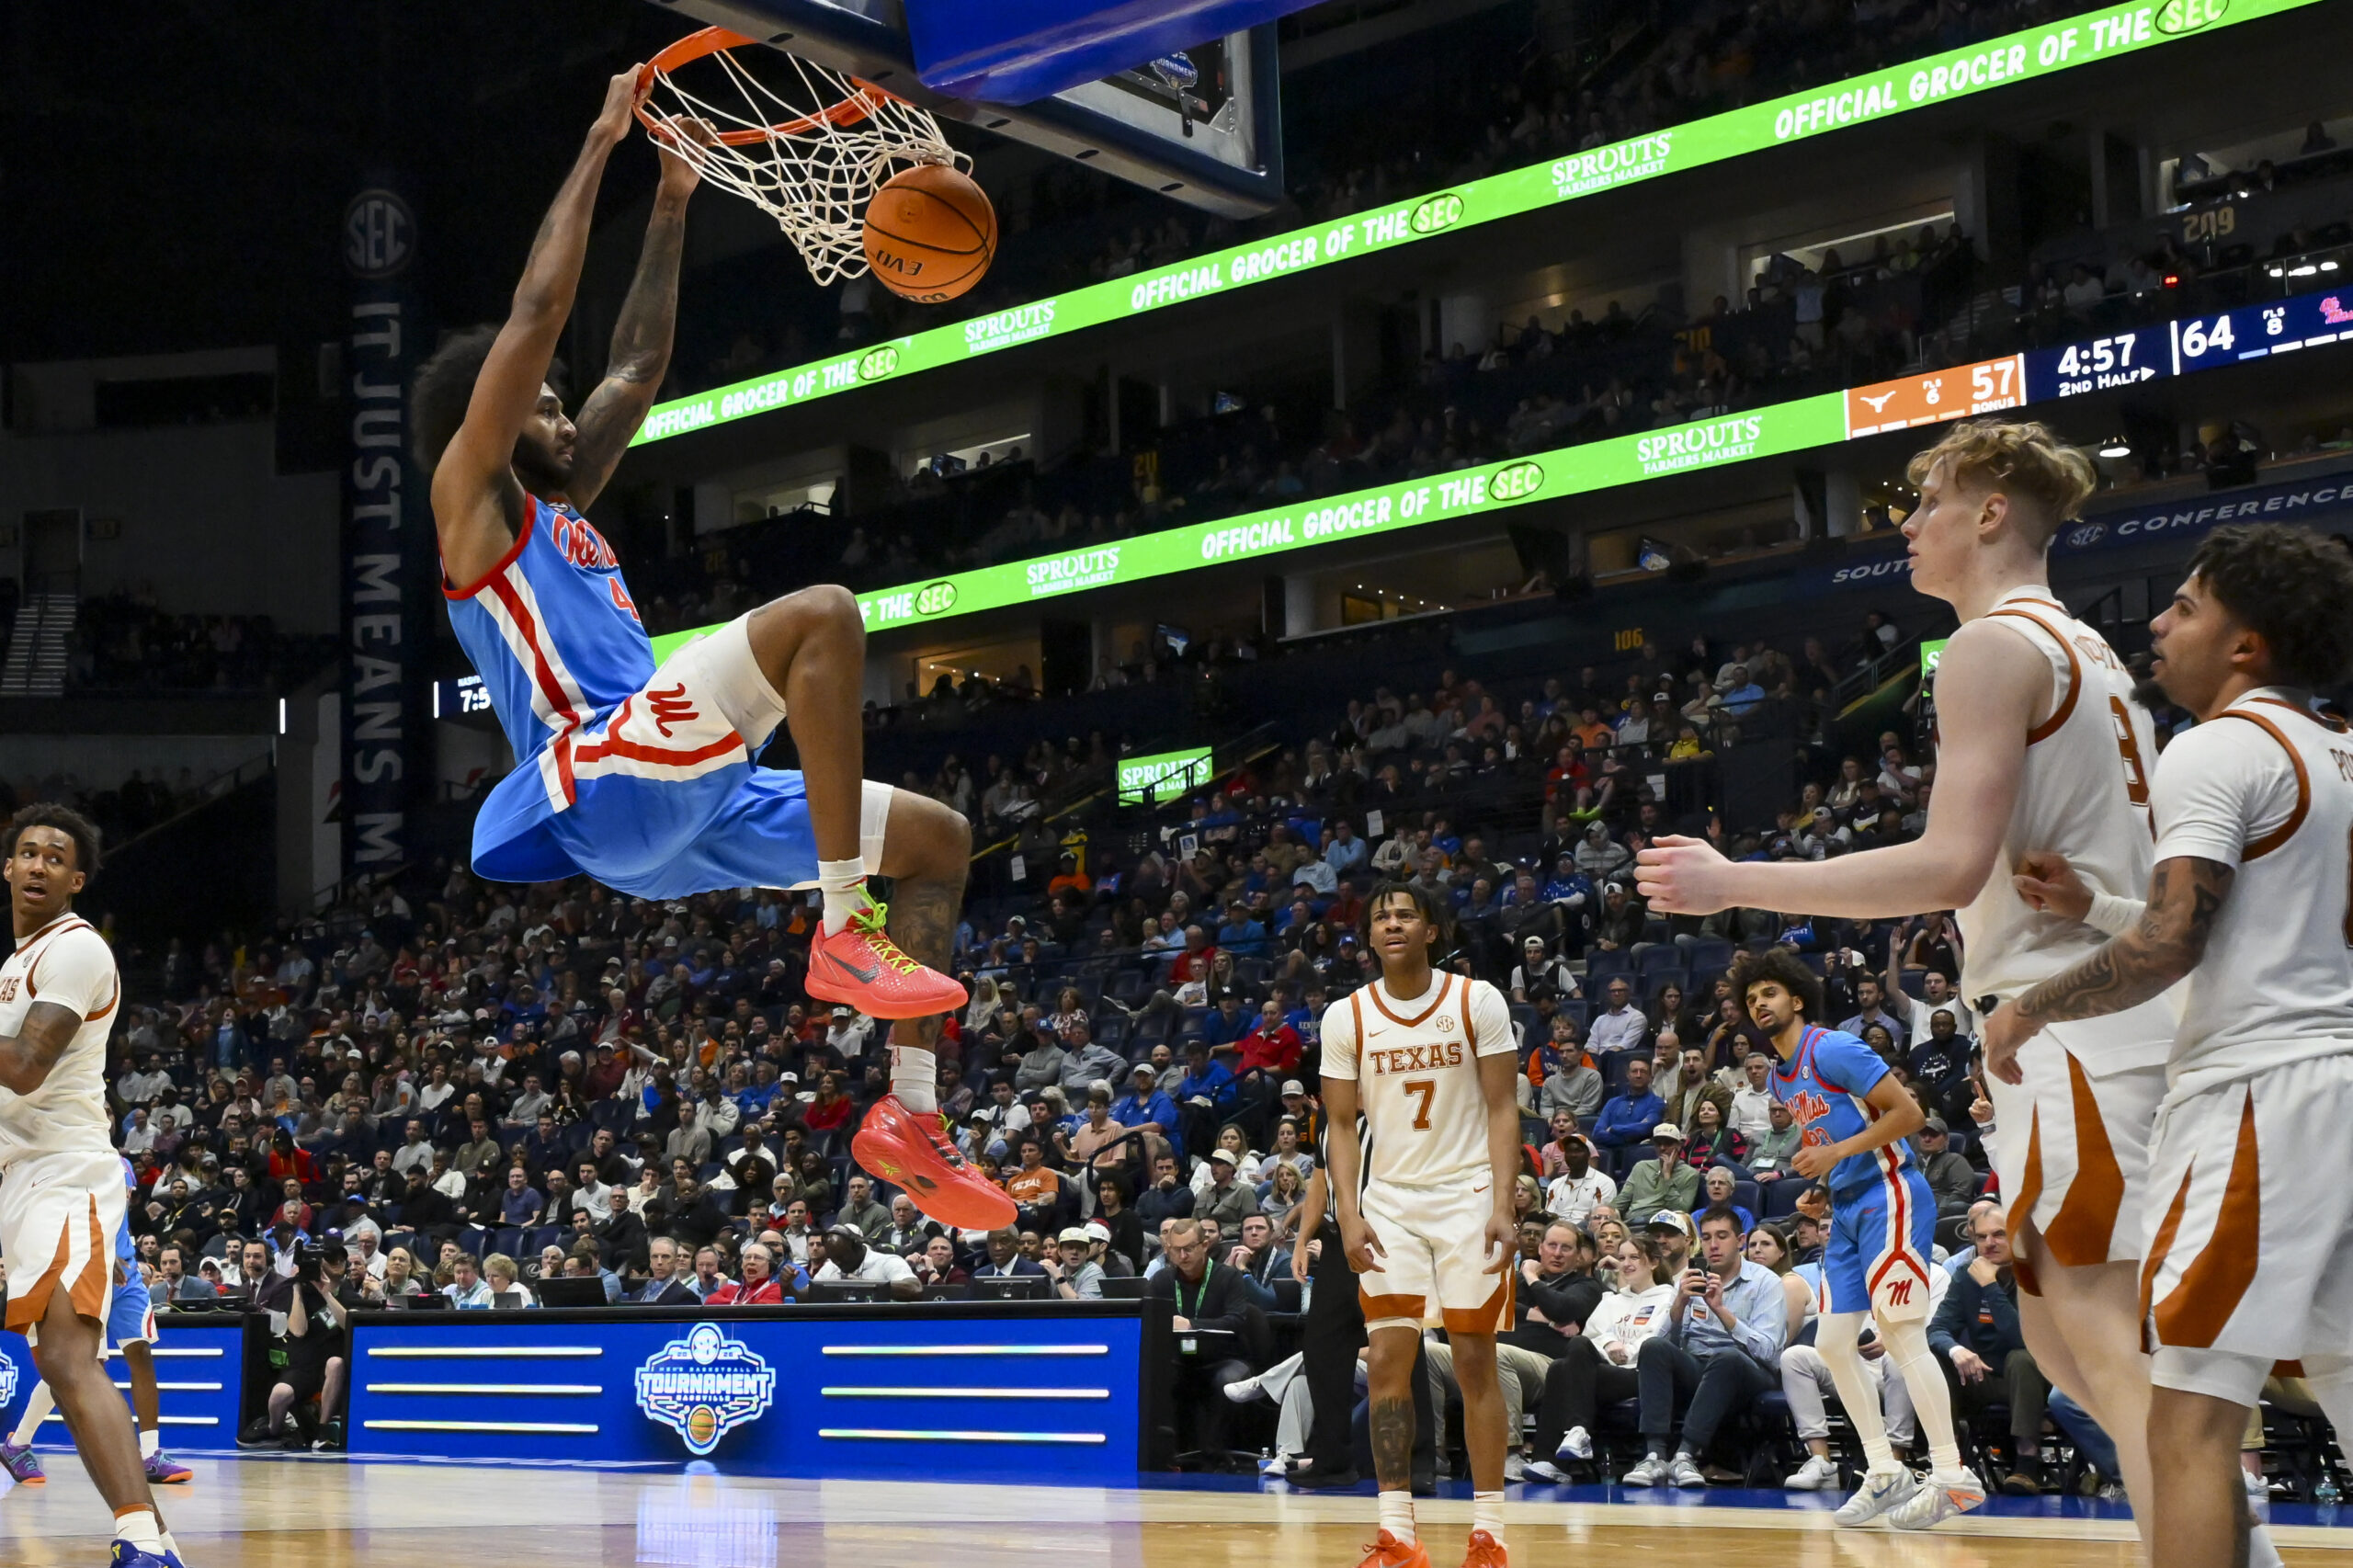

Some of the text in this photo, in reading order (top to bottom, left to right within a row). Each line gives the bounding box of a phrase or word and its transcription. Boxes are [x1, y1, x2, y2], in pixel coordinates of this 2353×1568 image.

[1775, 0, 2222, 139] OFFICIAL GROCER OF THE SEC
[1552, 132, 1672, 186] SPROUTS
[1558, 159, 1665, 198] FARMERS MARKET
[347, 199, 407, 269] SEC
[1131, 196, 1461, 310] OFFICIAL GROCER OF THE SEC
[876, 249, 924, 276] EVO
[353, 302, 402, 358] IT
[965, 300, 1056, 343] SPROUTS
[969, 323, 1051, 354] FARMERS MARKET
[2182, 315, 2234, 358] 64
[2267, 318, 2283, 335] 8
[2058, 334, 2135, 378] 4:57
[644, 349, 897, 439] OFFICIAL GROCER OF THE SEC
[1926, 388, 1940, 404] 6
[1972, 359, 2016, 401] 57
[2059, 380, 2093, 397] 2ND
[1971, 396, 2016, 415] BONUS
[353, 375, 402, 529] JUST
[1637, 415, 1762, 462] SPROUTS
[1643, 442, 1755, 474] FARMERS MARKET
[1200, 464, 1540, 560] OFFICIAL GROCER OF THE SEC
[2070, 524, 2107, 547] SEC
[1027, 547, 1120, 585] SPROUTS
[1074, 570, 1115, 588] MARKET
[877, 592, 913, 621] THE
[919, 584, 954, 614] SEC
[1615, 628, 1643, 651] 106
[353, 554, 403, 783] MEANS
[460, 686, 492, 712] 7:5
[1121, 756, 1209, 787] SPROUTS
[1437, 1016, 1455, 1033] SEC
[1368, 1040, 1463, 1076] TEXAS
[1403, 1077, 1437, 1131] 7
[641, 1372, 769, 1400] TOURNAMENT
